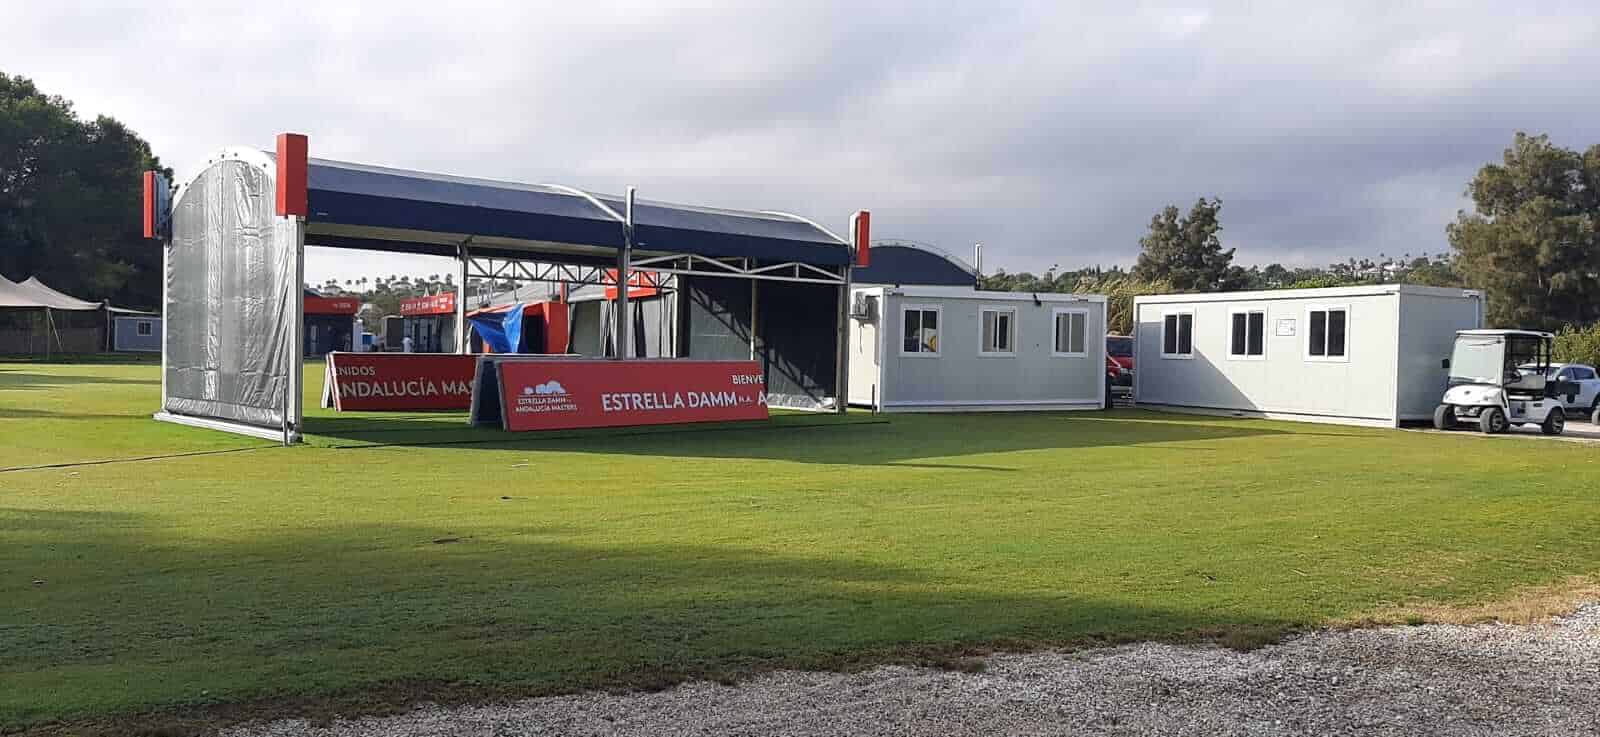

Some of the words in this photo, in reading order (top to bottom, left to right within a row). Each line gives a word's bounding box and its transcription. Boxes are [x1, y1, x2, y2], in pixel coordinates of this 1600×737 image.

[732, 374, 764, 385] BIENVE
[601, 392, 685, 411] ESTRELLA
[688, 391, 737, 408] DAMM
